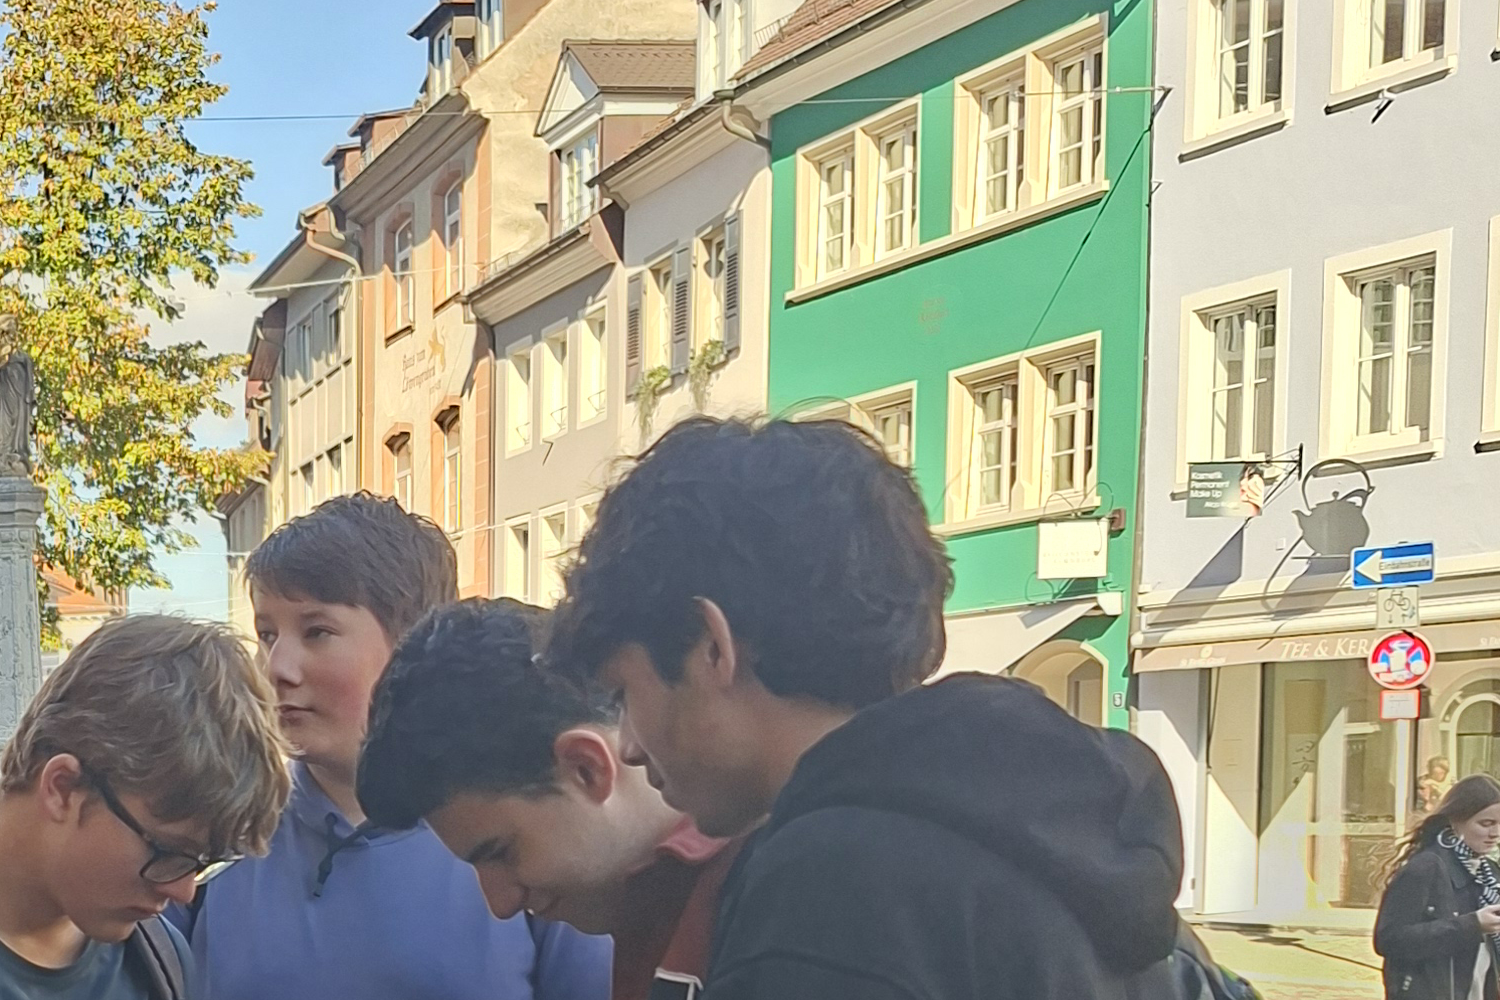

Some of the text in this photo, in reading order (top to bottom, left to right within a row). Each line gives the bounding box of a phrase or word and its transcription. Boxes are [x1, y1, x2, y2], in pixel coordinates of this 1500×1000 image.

[1190, 490, 1211, 498] Make
[1280, 637, 1378, 659] TEE & KER
[1114, 694, 1121, 706] 5
